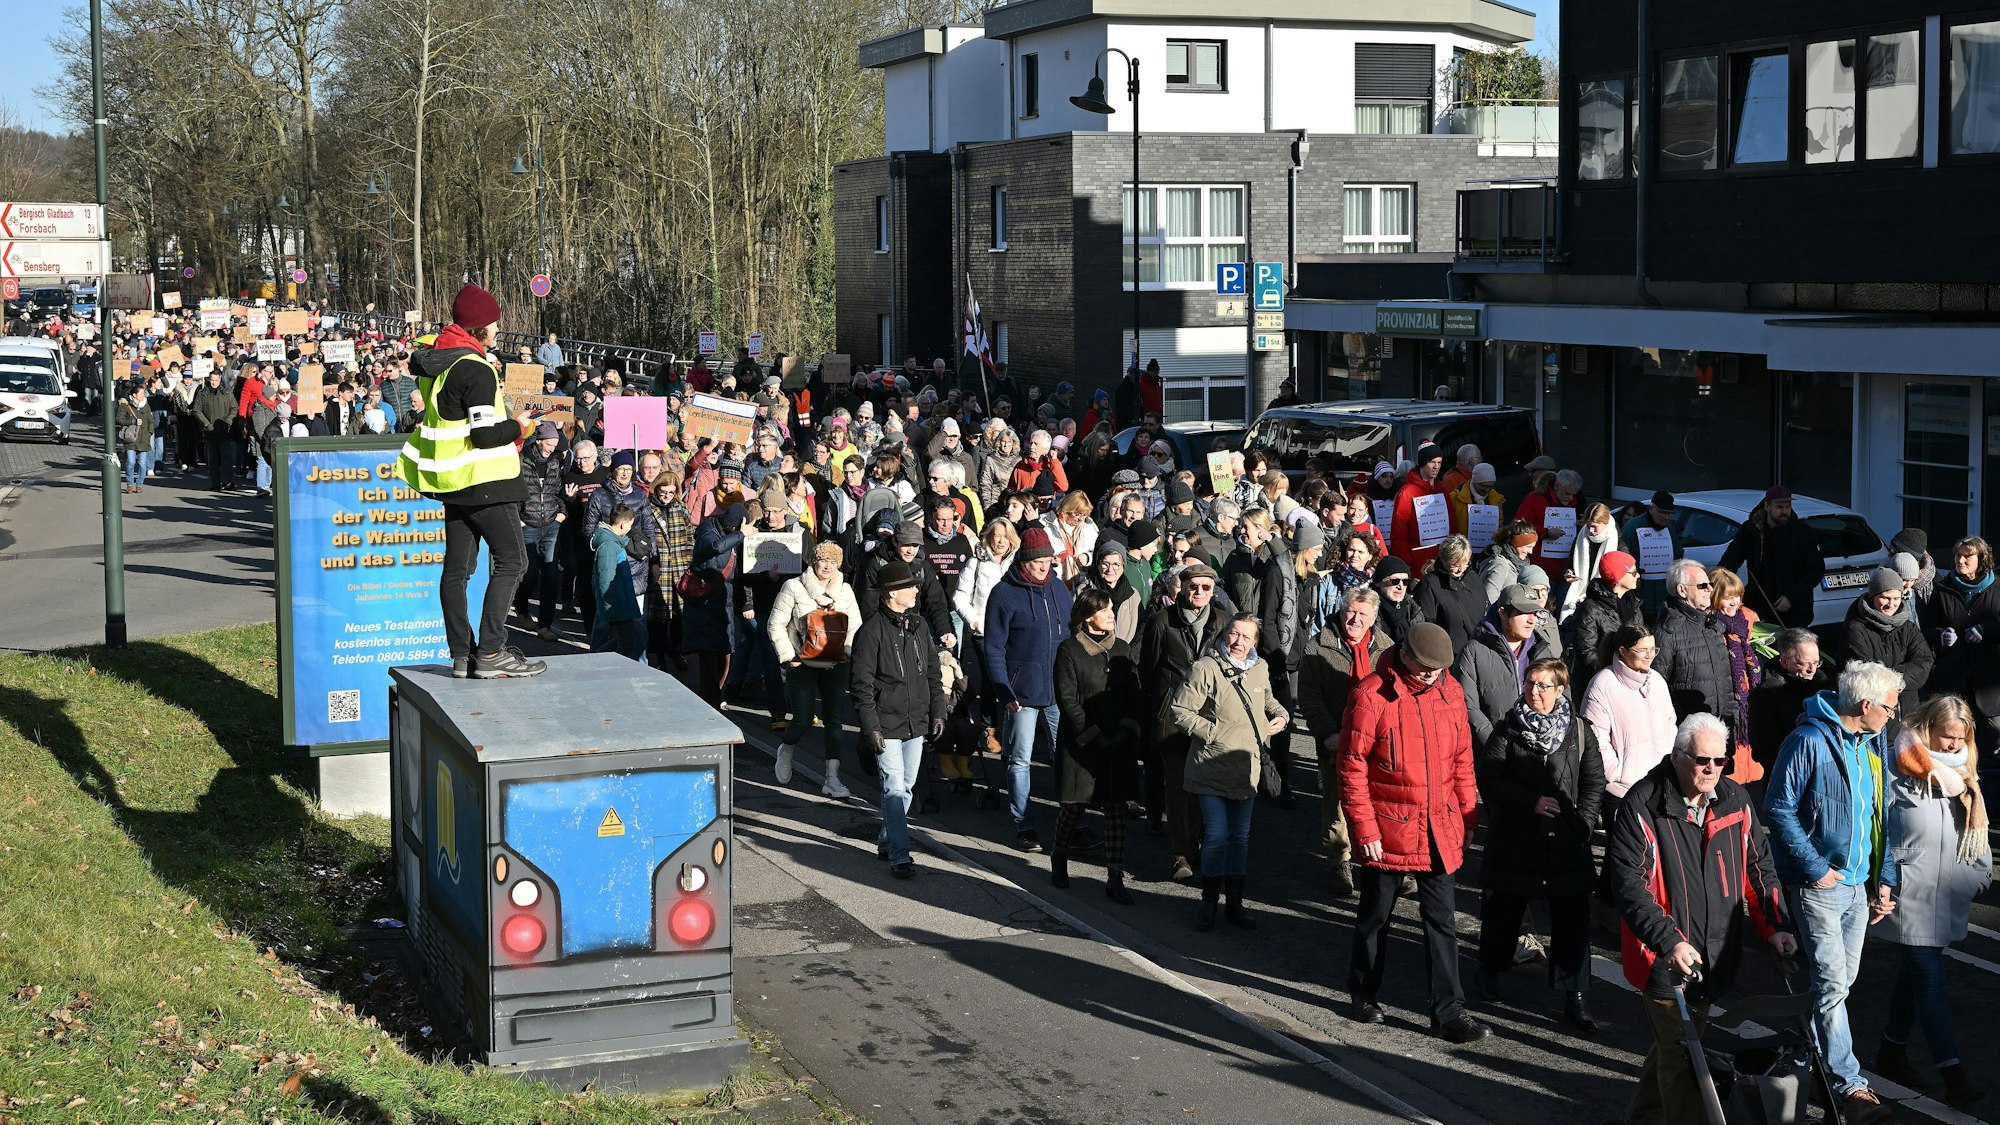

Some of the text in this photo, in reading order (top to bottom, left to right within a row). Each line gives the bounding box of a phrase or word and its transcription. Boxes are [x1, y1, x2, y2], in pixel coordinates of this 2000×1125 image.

[19, 208, 91, 220] Bergisch Gladbach 13
[20, 223, 57, 233] Forsbach
[24, 261, 92, 273] Bensberg 11
[1223, 267, 1238, 290] P
[1258, 266, 1271, 284] P
[6, 284, 14, 292] 75
[1377, 312, 1439, 329] PROVINZIAL
[306, 463, 398, 481] Jesus C
[1213, 473, 1229, 481] keine
[358, 486, 421, 500] Ich bin
[332, 507, 445, 524] der Weg und
[332, 528, 447, 545] die Wahrheit
[321, 550, 444, 568] und das Lebe
[1827, 576, 1837, 586] GL
[355, 593, 392, 601] Johannes
[345, 619, 444, 632] Neues Testament
[334, 638, 390, 649] kostenlos
[332, 648, 451, 665] Telefon 0800 5894 80
